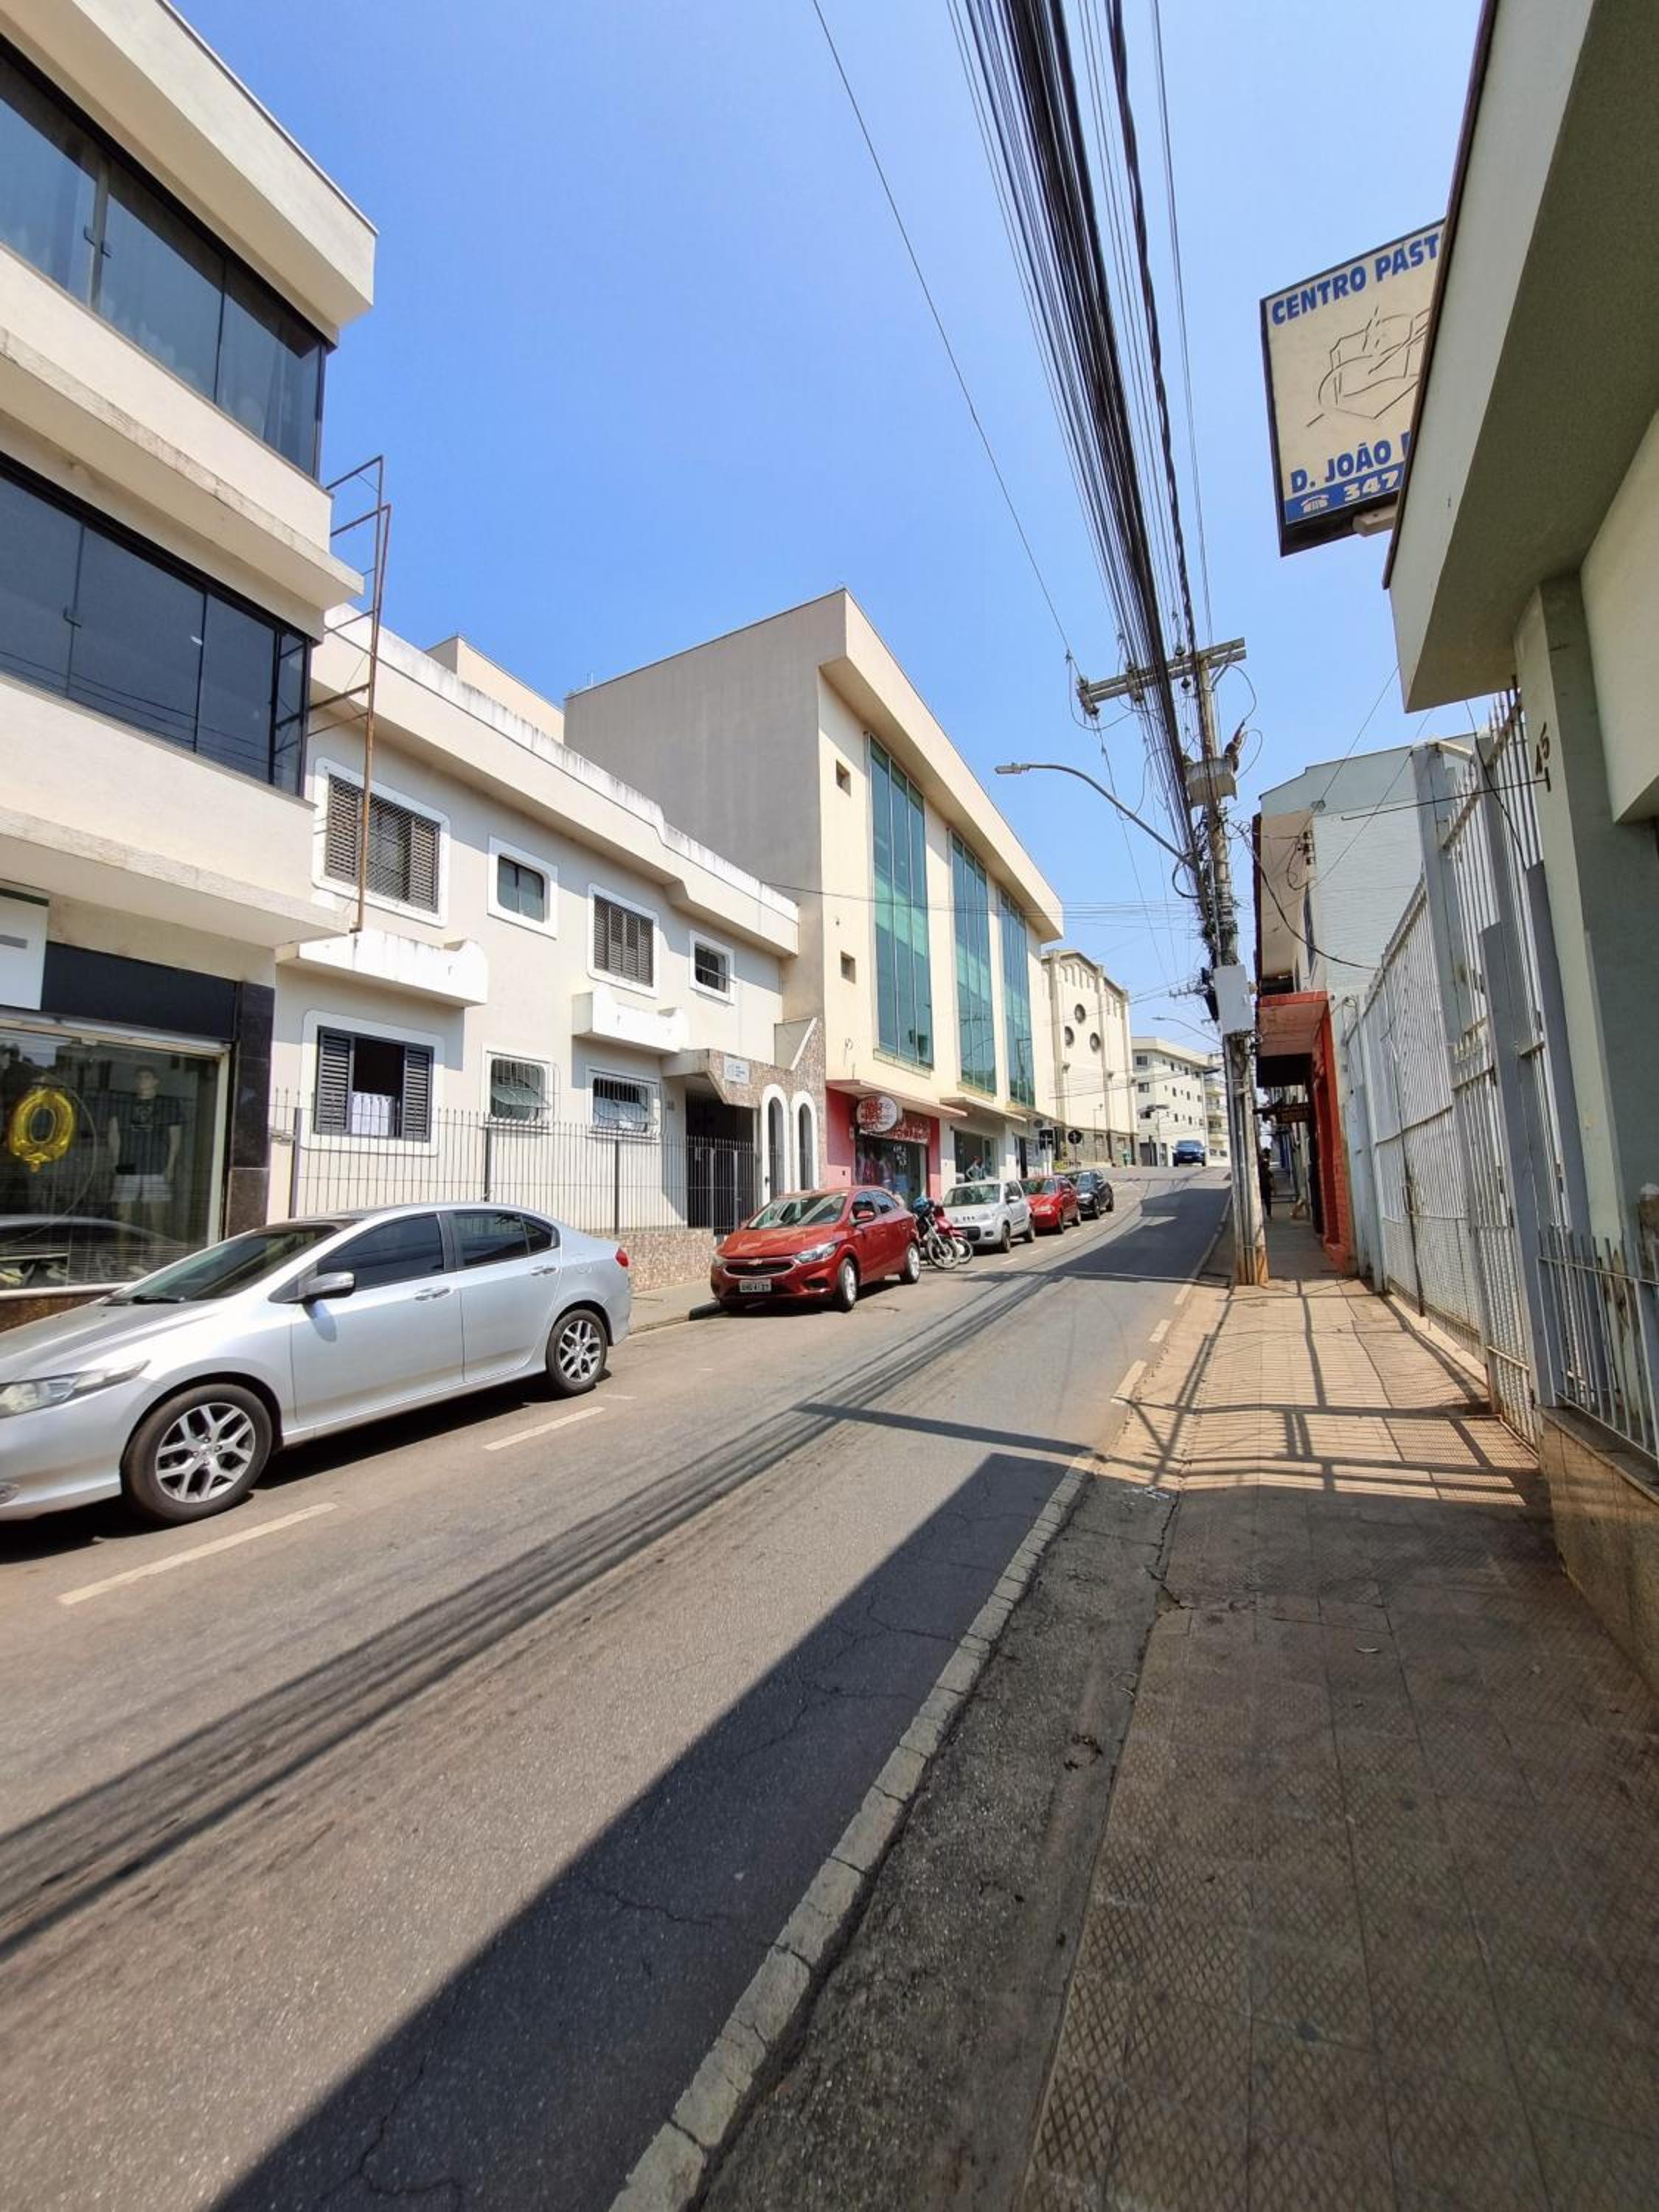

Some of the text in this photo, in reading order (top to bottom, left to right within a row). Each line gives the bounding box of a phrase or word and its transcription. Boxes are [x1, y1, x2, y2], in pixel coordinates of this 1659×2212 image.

[1272, 233, 1439, 325] CENTRO PAST
[1290, 468, 1316, 494] D.
[1325, 443, 1391, 482] JOÃO
[1343, 470, 1399, 502] 347
